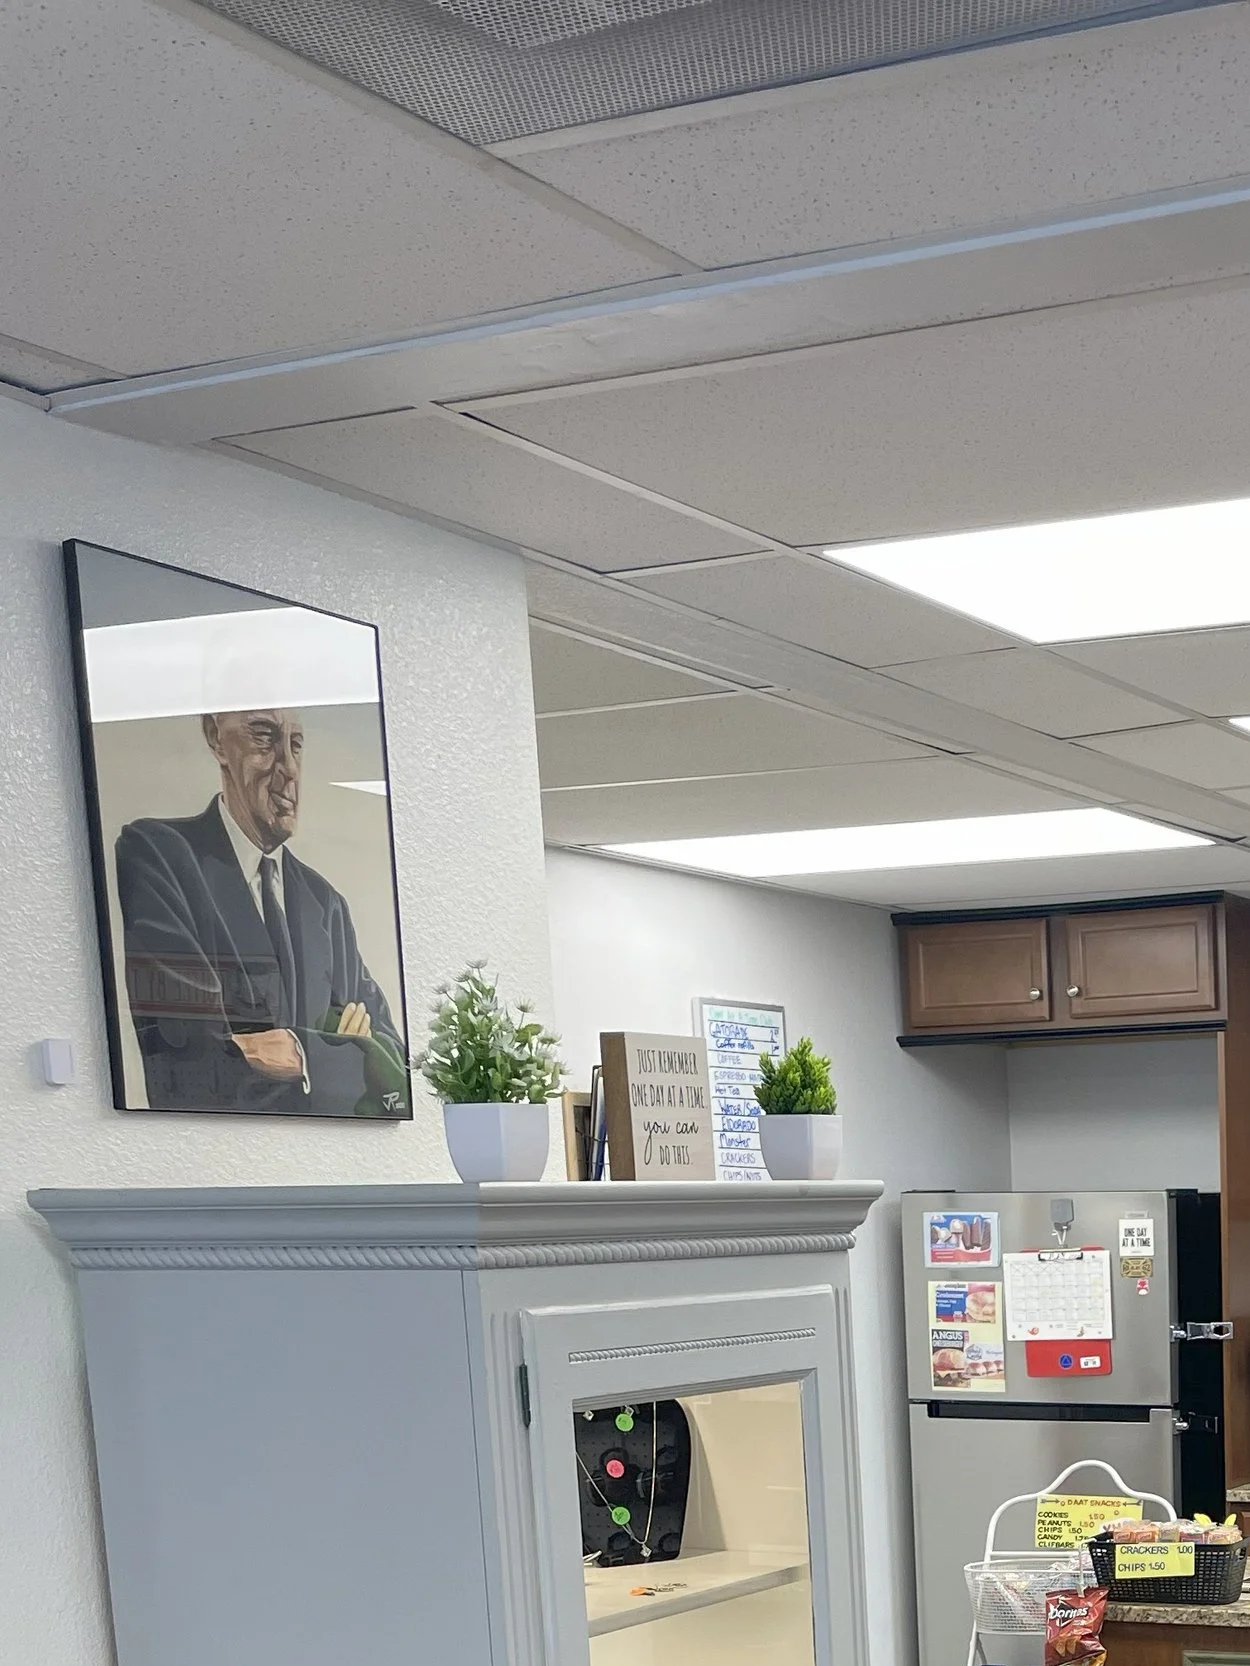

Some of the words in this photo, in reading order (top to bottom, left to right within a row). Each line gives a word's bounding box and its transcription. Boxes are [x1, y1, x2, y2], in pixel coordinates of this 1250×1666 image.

[637, 1048, 656, 1075] JUST
[658, 1050, 698, 1075] REMEMBER
[631, 1083, 649, 1107] ONE
[650, 1084, 665, 1107] DAY
[668, 1085, 676, 1108] AT
[679, 1086, 684, 1108] A
[643, 1121, 671, 1165] you
[675, 1121, 699, 1134] can
[720, 1133, 751, 1148] Monster
[659, 1145, 671, 1165] DO
[672, 1145, 693, 1165] THIS.
[721, 1152, 756, 1164] CRACKERS
[1124, 1228, 1135, 1237] ONE
[1137, 1228, 1147, 1237] DAY
[1122, 1238, 1129, 1247] AT
[1131, 1238, 1135, 1247] A
[1136, 1237, 1151, 1247] TIME
[932, 1331, 964, 1341] ANGUS
[1037, 1519, 1072, 1527] PEANUTS
[1120, 1545, 1169, 1555] CRACKERS
[1118, 1563, 1146, 1572] CHIPS
